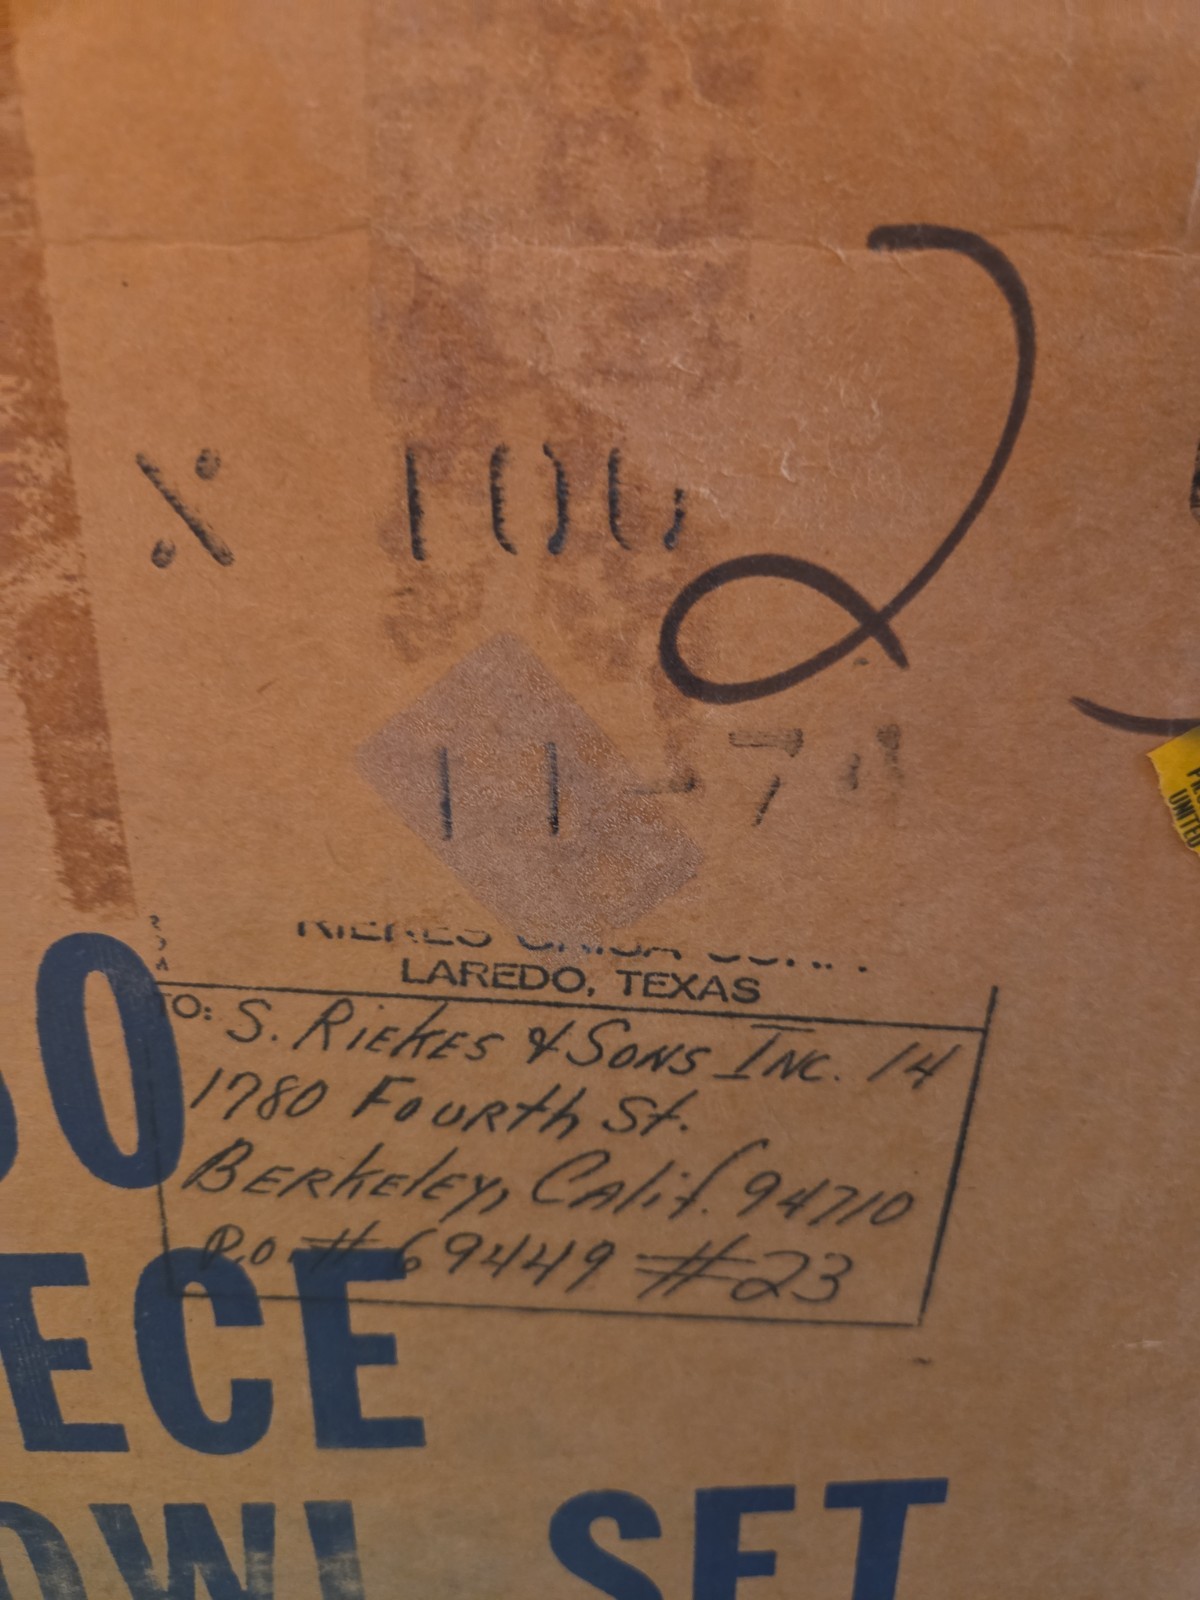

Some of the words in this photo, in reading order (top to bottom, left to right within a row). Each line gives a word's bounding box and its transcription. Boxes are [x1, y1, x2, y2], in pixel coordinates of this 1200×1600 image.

[400, 957, 596, 998] LAREDO,
[615, 968, 761, 1004] TEXAS
[225, 999, 278, 1043] S.
[190, 1068, 328, 1120] 1780
[736, 1170, 914, 1228] 94710
